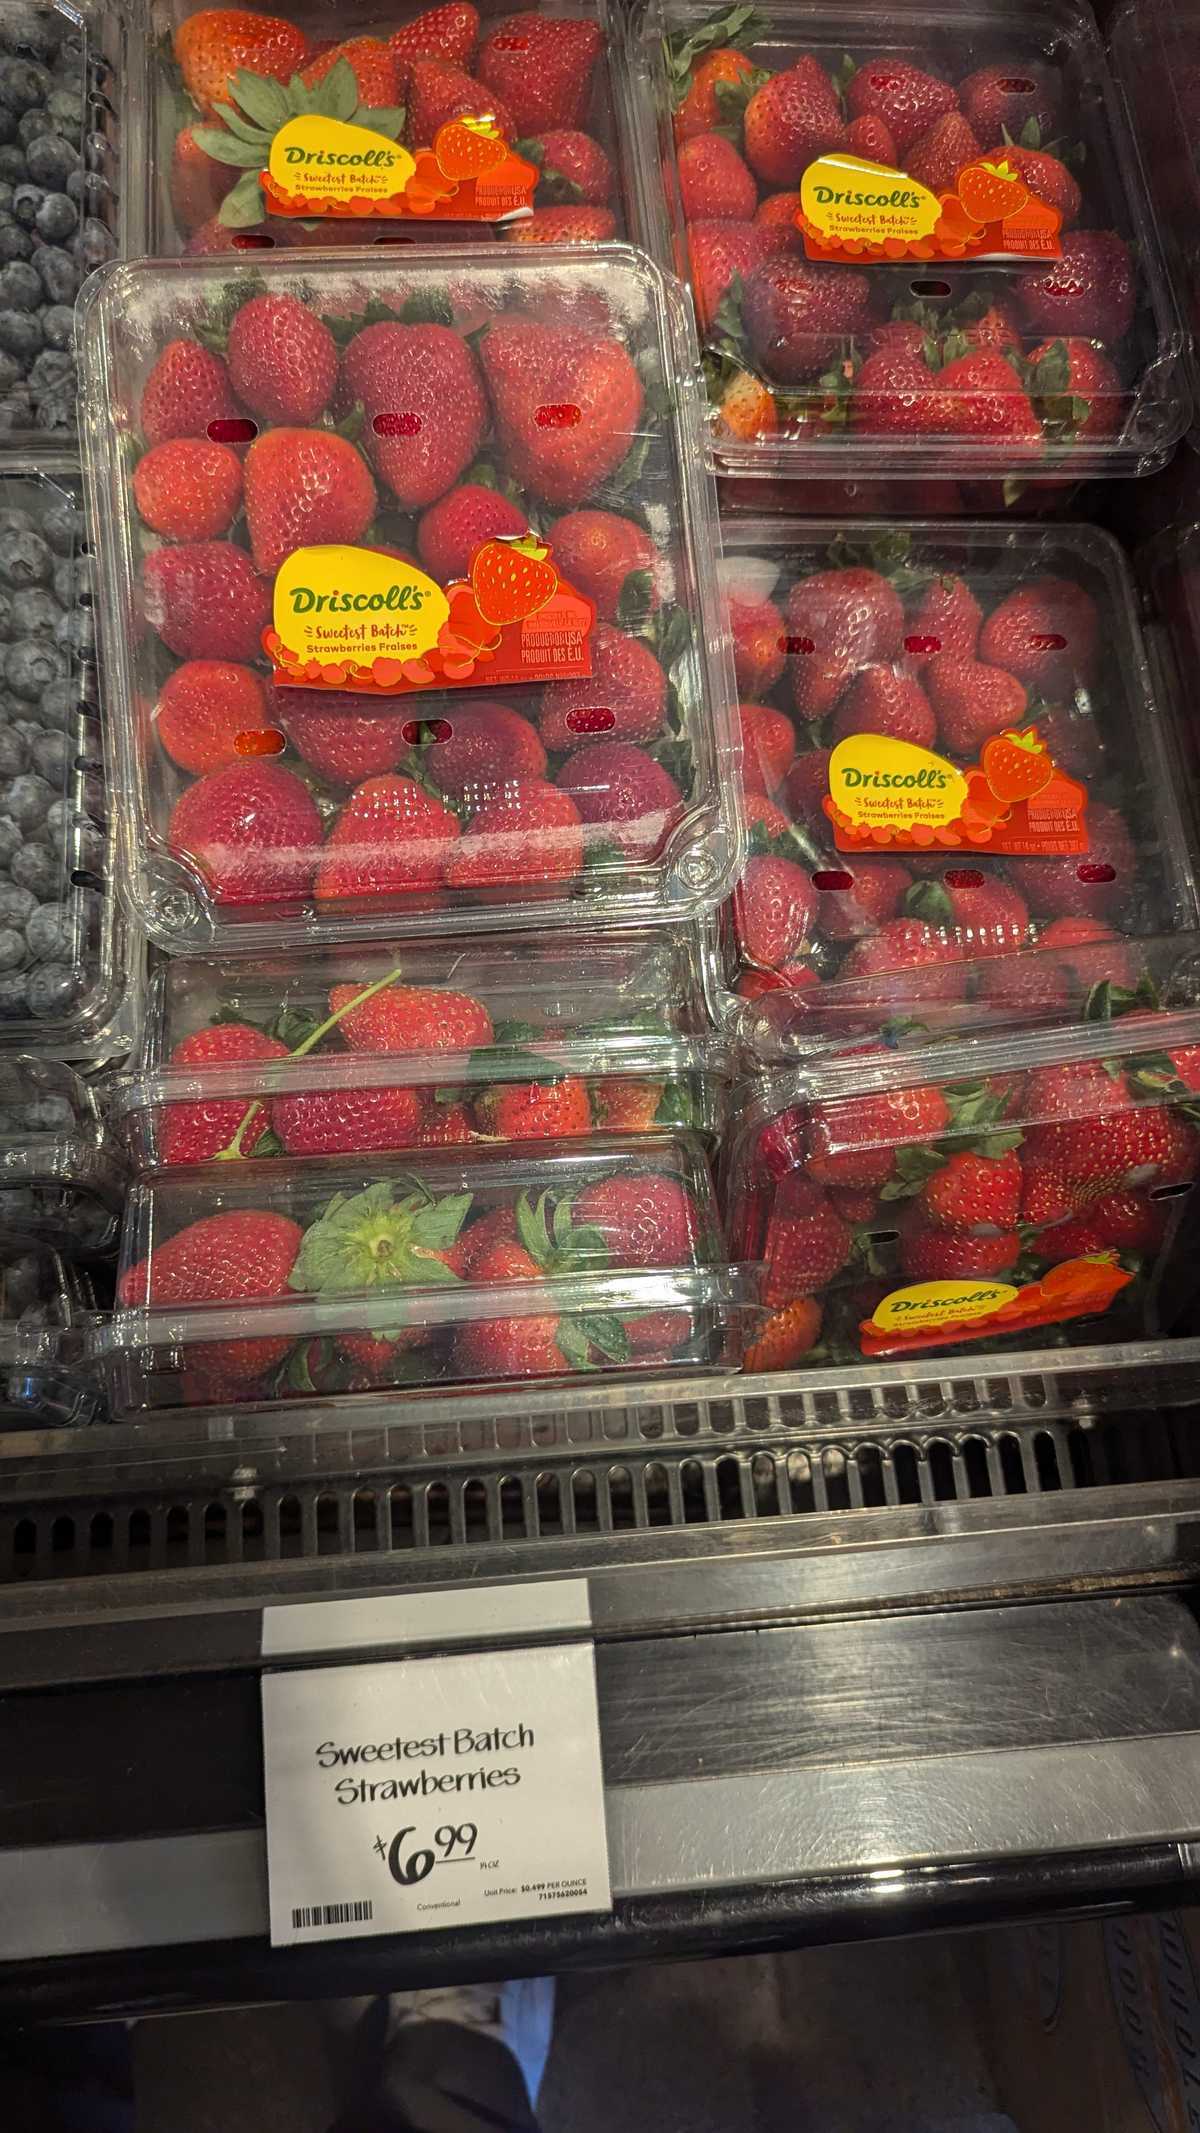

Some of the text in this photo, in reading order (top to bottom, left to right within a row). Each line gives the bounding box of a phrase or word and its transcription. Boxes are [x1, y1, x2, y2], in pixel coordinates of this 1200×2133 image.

[285, 147, 395, 167] Driscoll's
[812, 186, 920, 208] Driscoll's
[315, 624, 366, 640] Sweetest
[564, 631, 583, 646] USA
[306, 642, 418, 654] Strawberries Fraises
[521, 648, 551, 663] PRODUIT
[553, 647, 566, 662] DES
[841, 767, 946, 788] Driscoll's
[890, 1289, 1001, 1313] Driscoll's
[315, 1723, 535, 1769] Sweetest Batch
[334, 1766, 521, 1805] Strawberries
[547, 1880, 560, 1889] PER
[561, 1878, 587, 1887] OUNCE
[416, 1898, 461, 1911] Conventional
